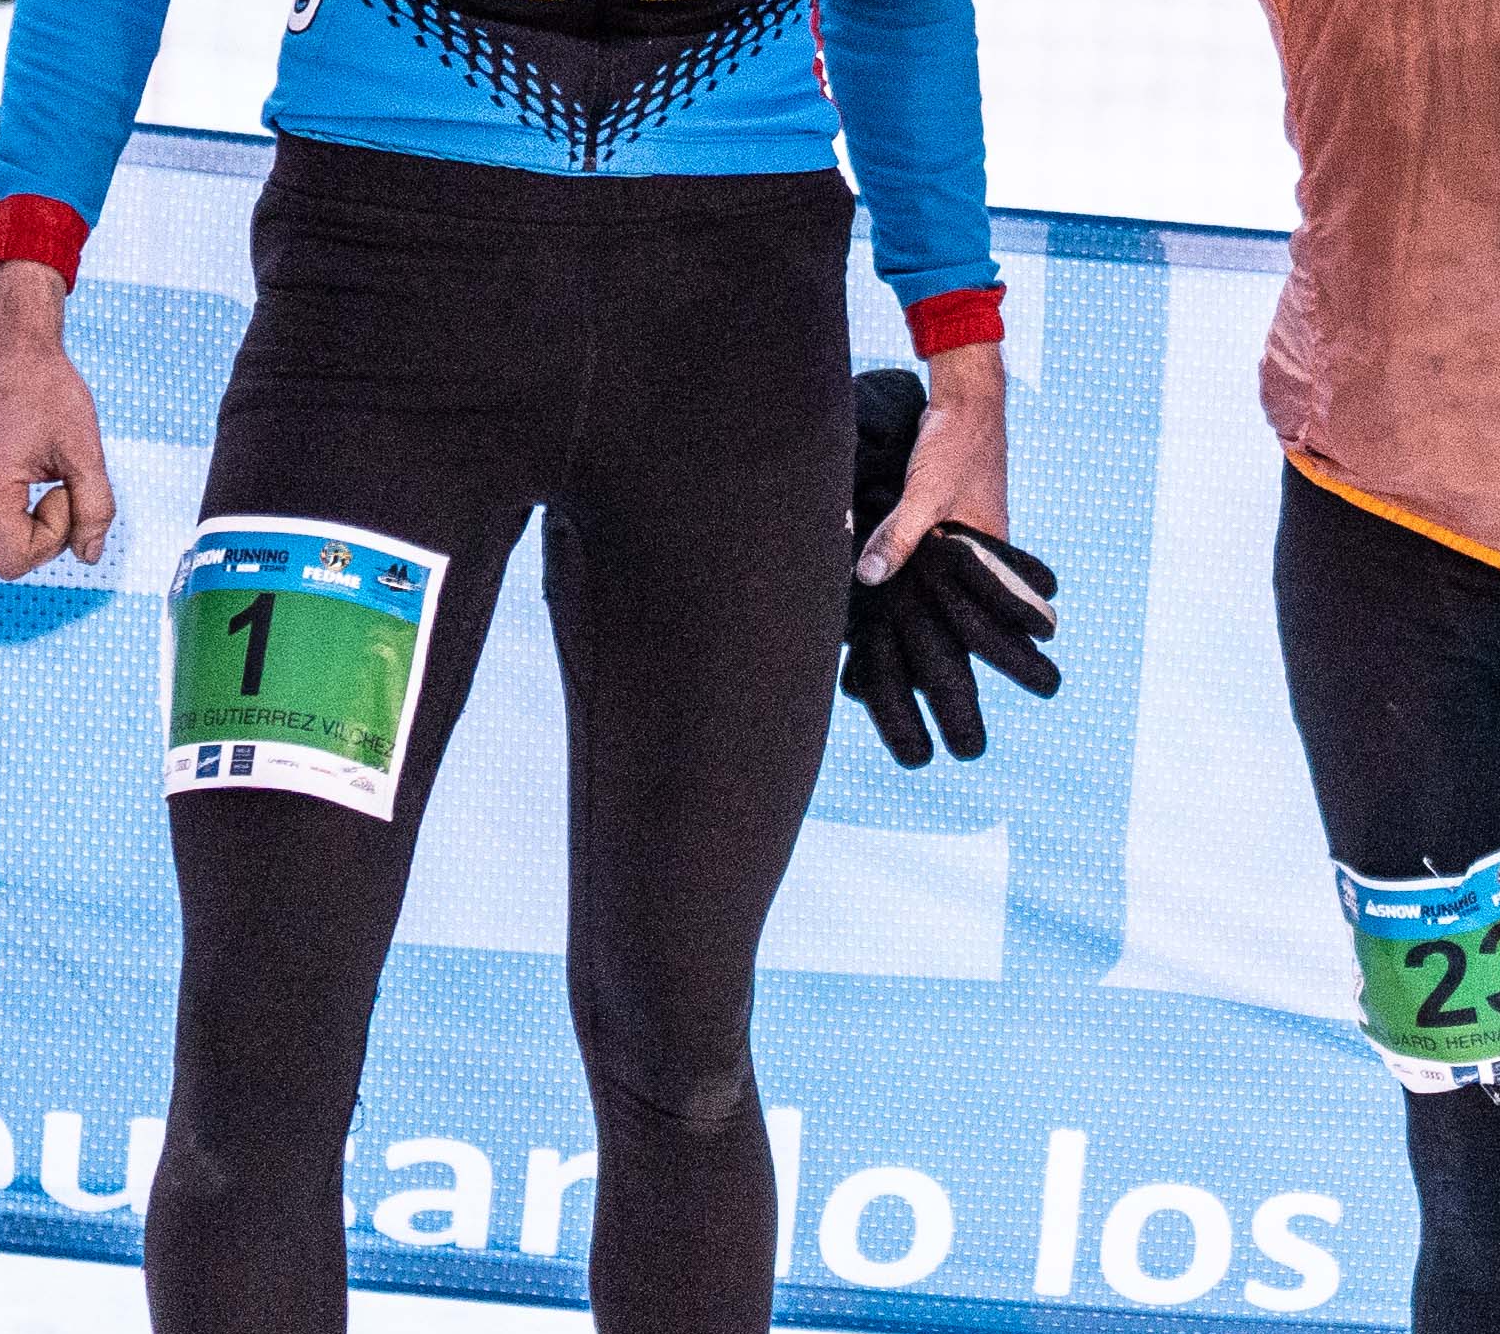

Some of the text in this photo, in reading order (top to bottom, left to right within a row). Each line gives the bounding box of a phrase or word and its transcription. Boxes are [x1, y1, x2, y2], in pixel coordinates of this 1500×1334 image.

[227, 592, 276, 697] 1
[203, 708, 316, 732] GUTIERREZ
[322, 719, 396, 758] VILCHEZ
[1033, 1128, 1341, 1313] los
